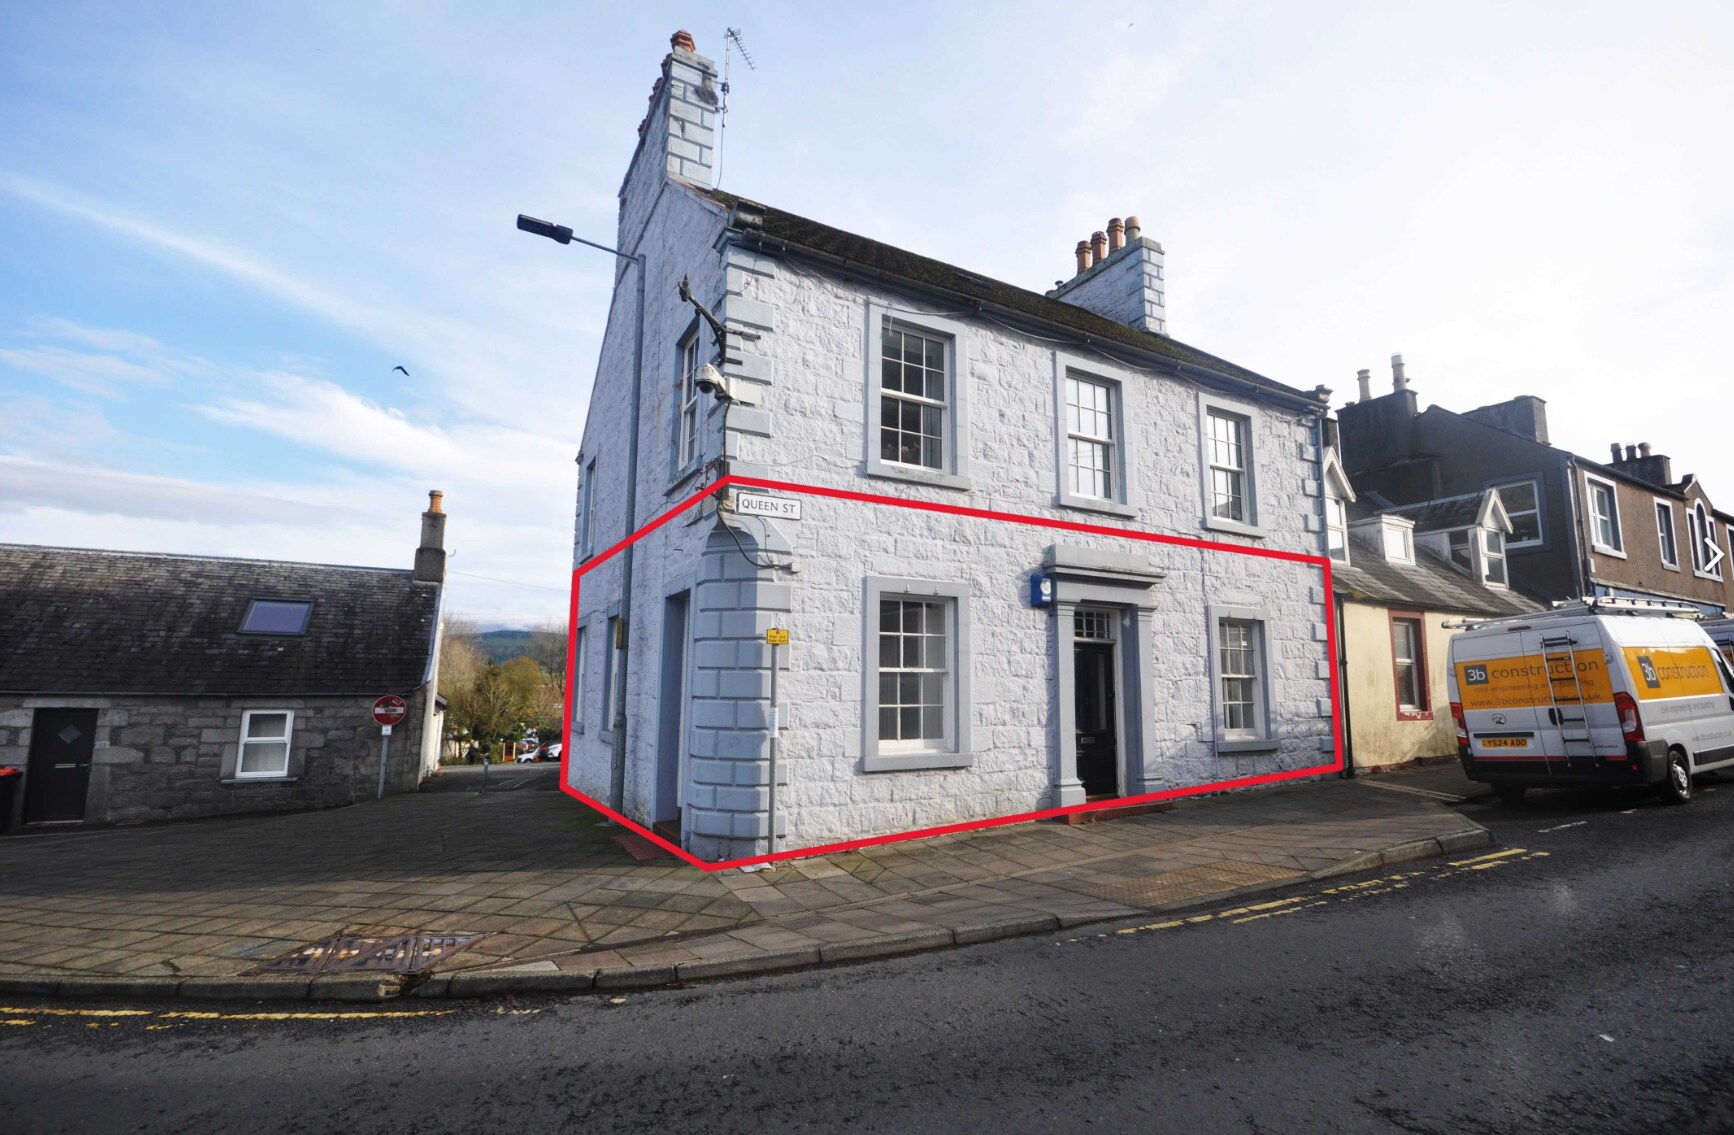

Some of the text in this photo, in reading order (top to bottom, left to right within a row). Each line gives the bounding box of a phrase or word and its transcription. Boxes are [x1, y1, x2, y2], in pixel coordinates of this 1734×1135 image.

[742, 499, 796, 513] QUEEN ST
[1467, 660, 1599, 681] 3b constructon
[1641, 661, 1710, 681] 3b construction
[1490, 683, 1538, 692] engineering
